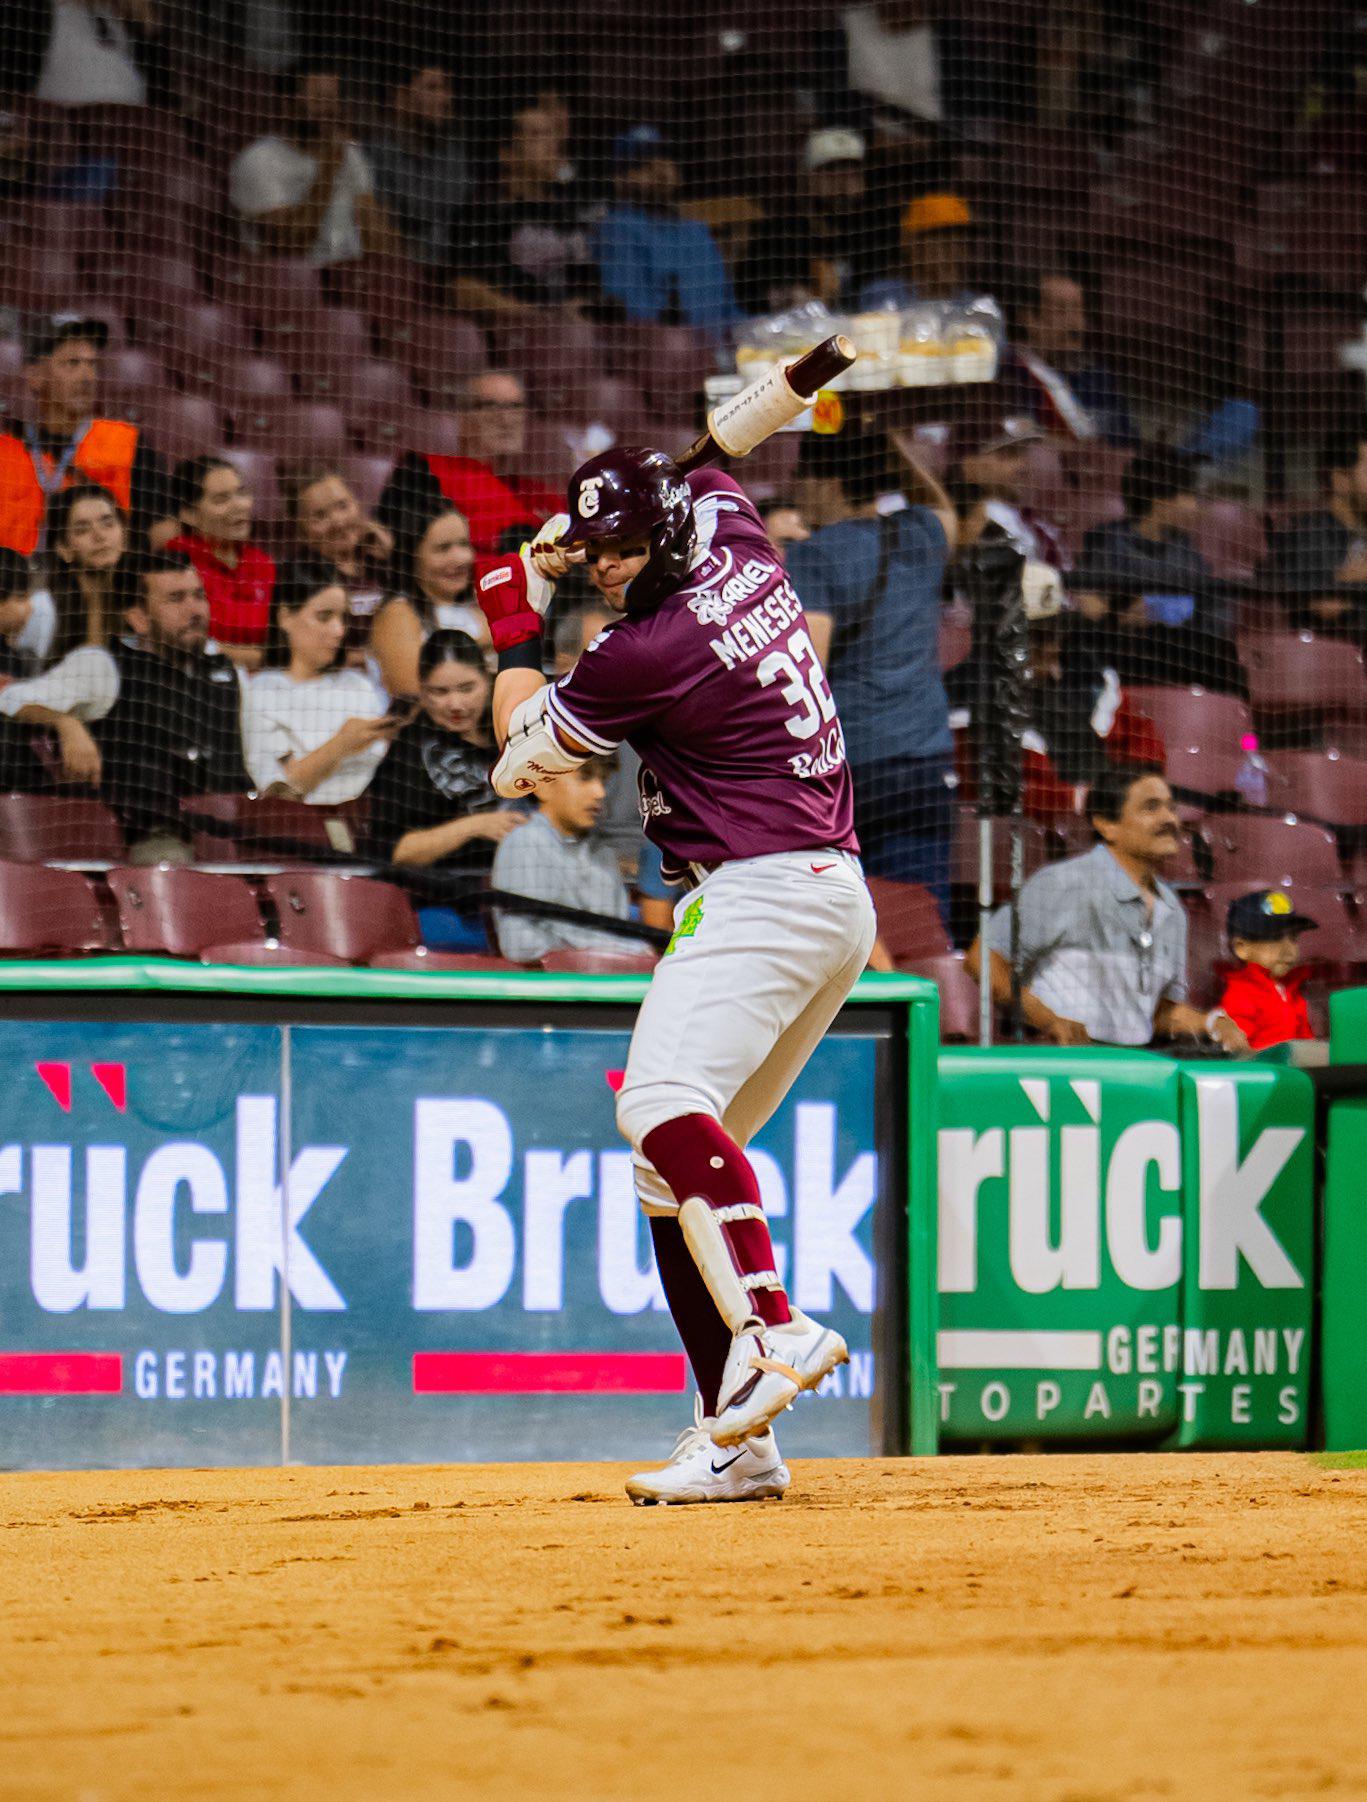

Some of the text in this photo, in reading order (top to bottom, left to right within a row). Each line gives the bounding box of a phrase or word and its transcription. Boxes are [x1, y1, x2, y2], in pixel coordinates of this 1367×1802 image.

[709, 578, 803, 671] MENESES
[757, 627, 838, 740] 32
[134, 1350, 349, 1398] GERMANY
